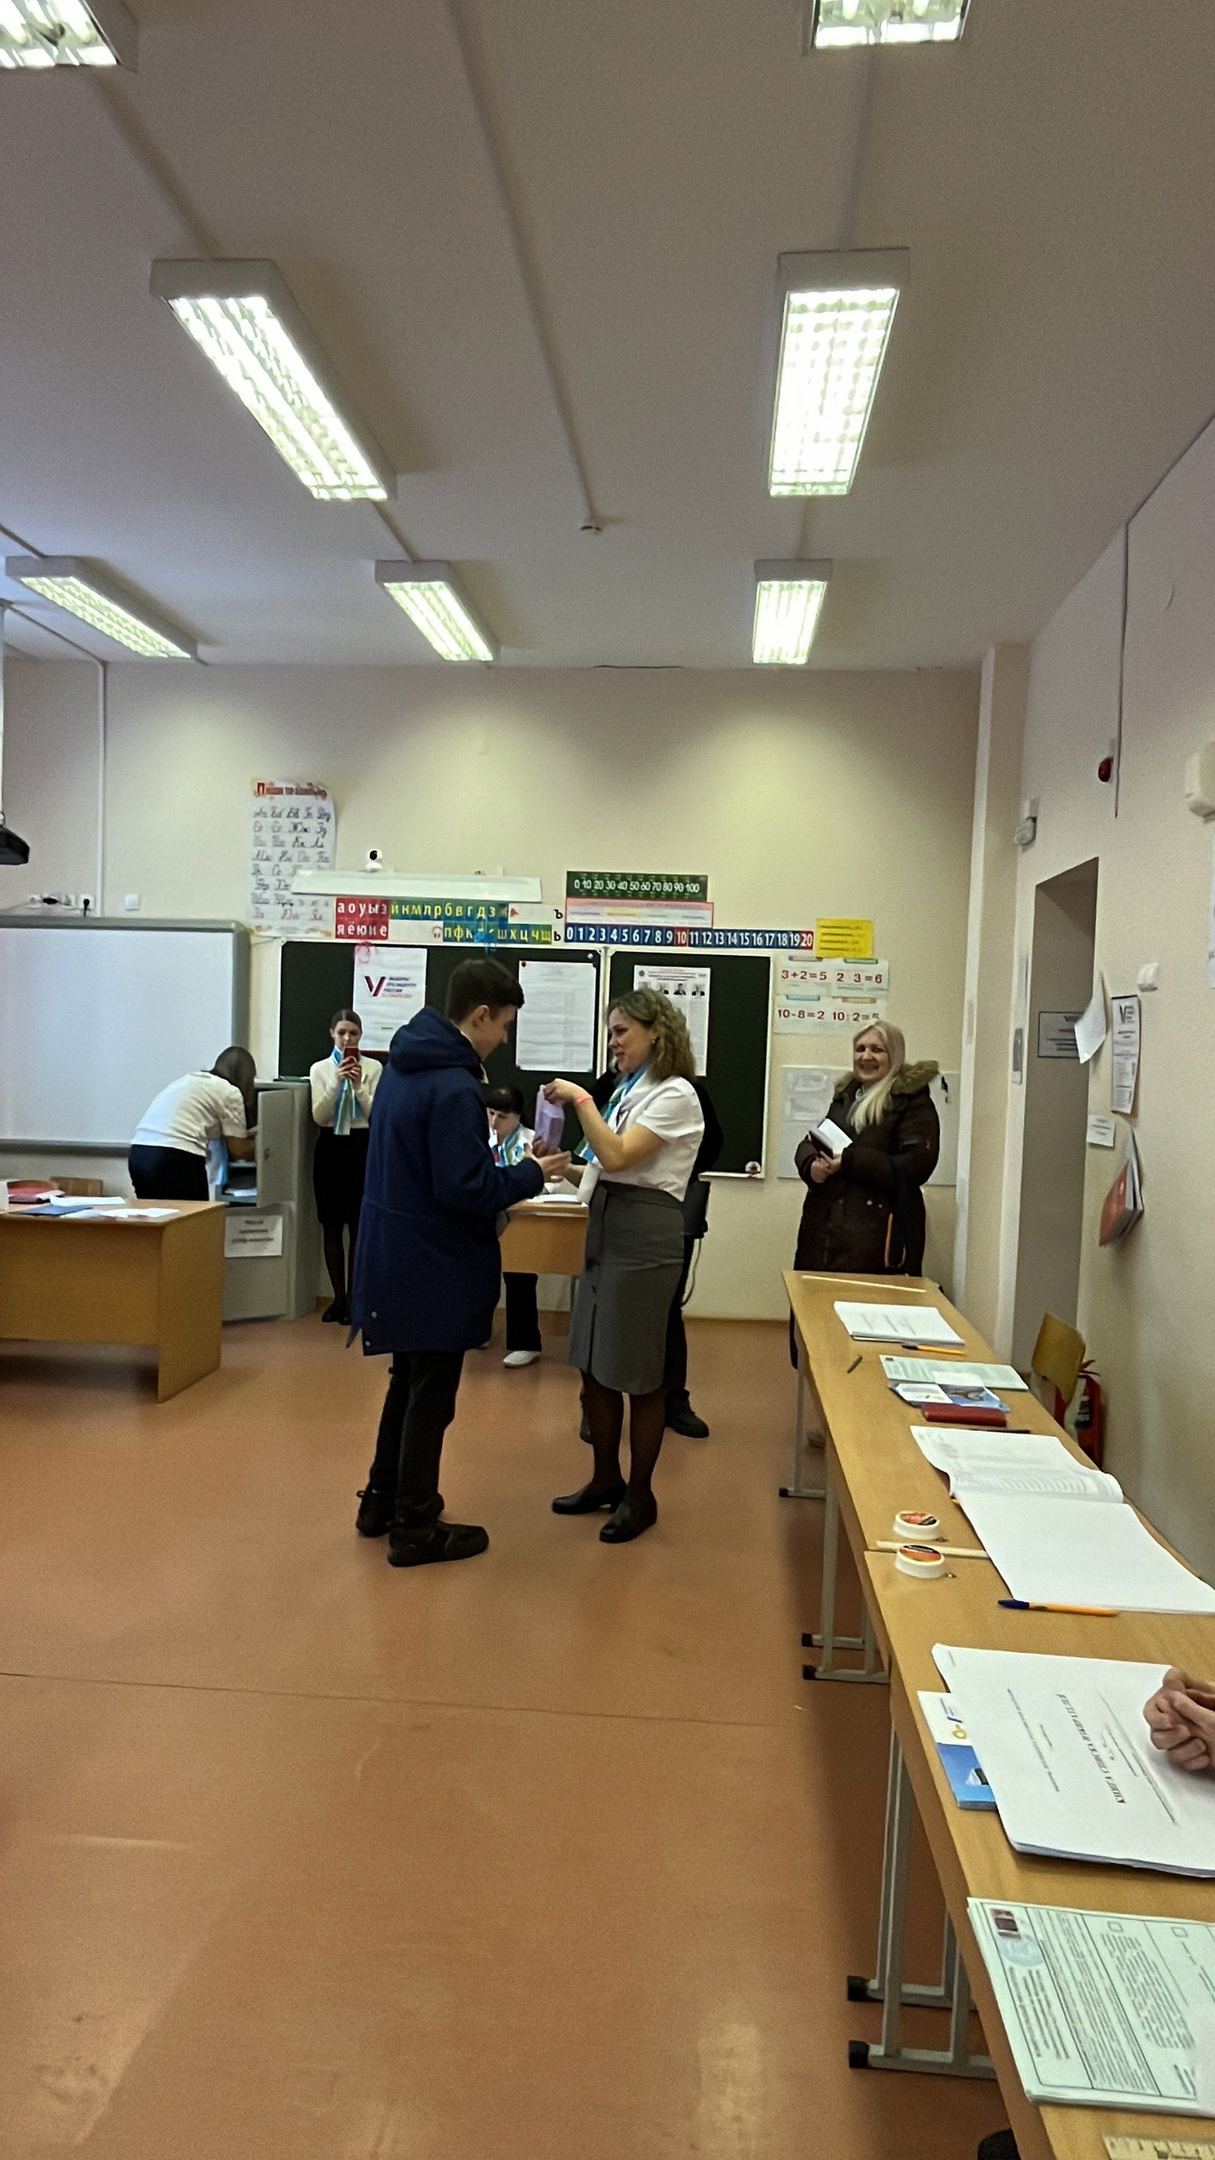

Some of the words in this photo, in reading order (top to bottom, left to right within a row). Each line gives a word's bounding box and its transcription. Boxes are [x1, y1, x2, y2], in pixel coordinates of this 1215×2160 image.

[606, 881, 616, 890] 30
[662, 882, 672, 892] 80
[674, 883, 684, 893] 90
[686, 883, 700, 893] 100
[566, 927, 574, 940] 0
[578, 928, 584, 940] 1
[589, 928, 596, 941] 2
[600, 928, 606, 941] 3
[610, 928, 618, 942] 4
[622, 929, 628, 942] 5
[632, 929, 640, 942] 6
[644, 930, 651, 943] 7
[655, 930, 662, 943] 8
[666, 930, 673, 943] 9
[677, 931, 687, 944] 10
[690, 931, 699, 944] 11
[702, 932, 712, 945] 12
[714, 932, 725, 945] 13
[727, 932, 737, 945] 14
[740, 933, 750, 945] 15
[752, 933, 762, 946] 16
[765, 933, 775, 946] 17
[777, 933, 788, 946] 18
[790, 933, 800, 946] 19
[801, 933, 813, 947] 20
